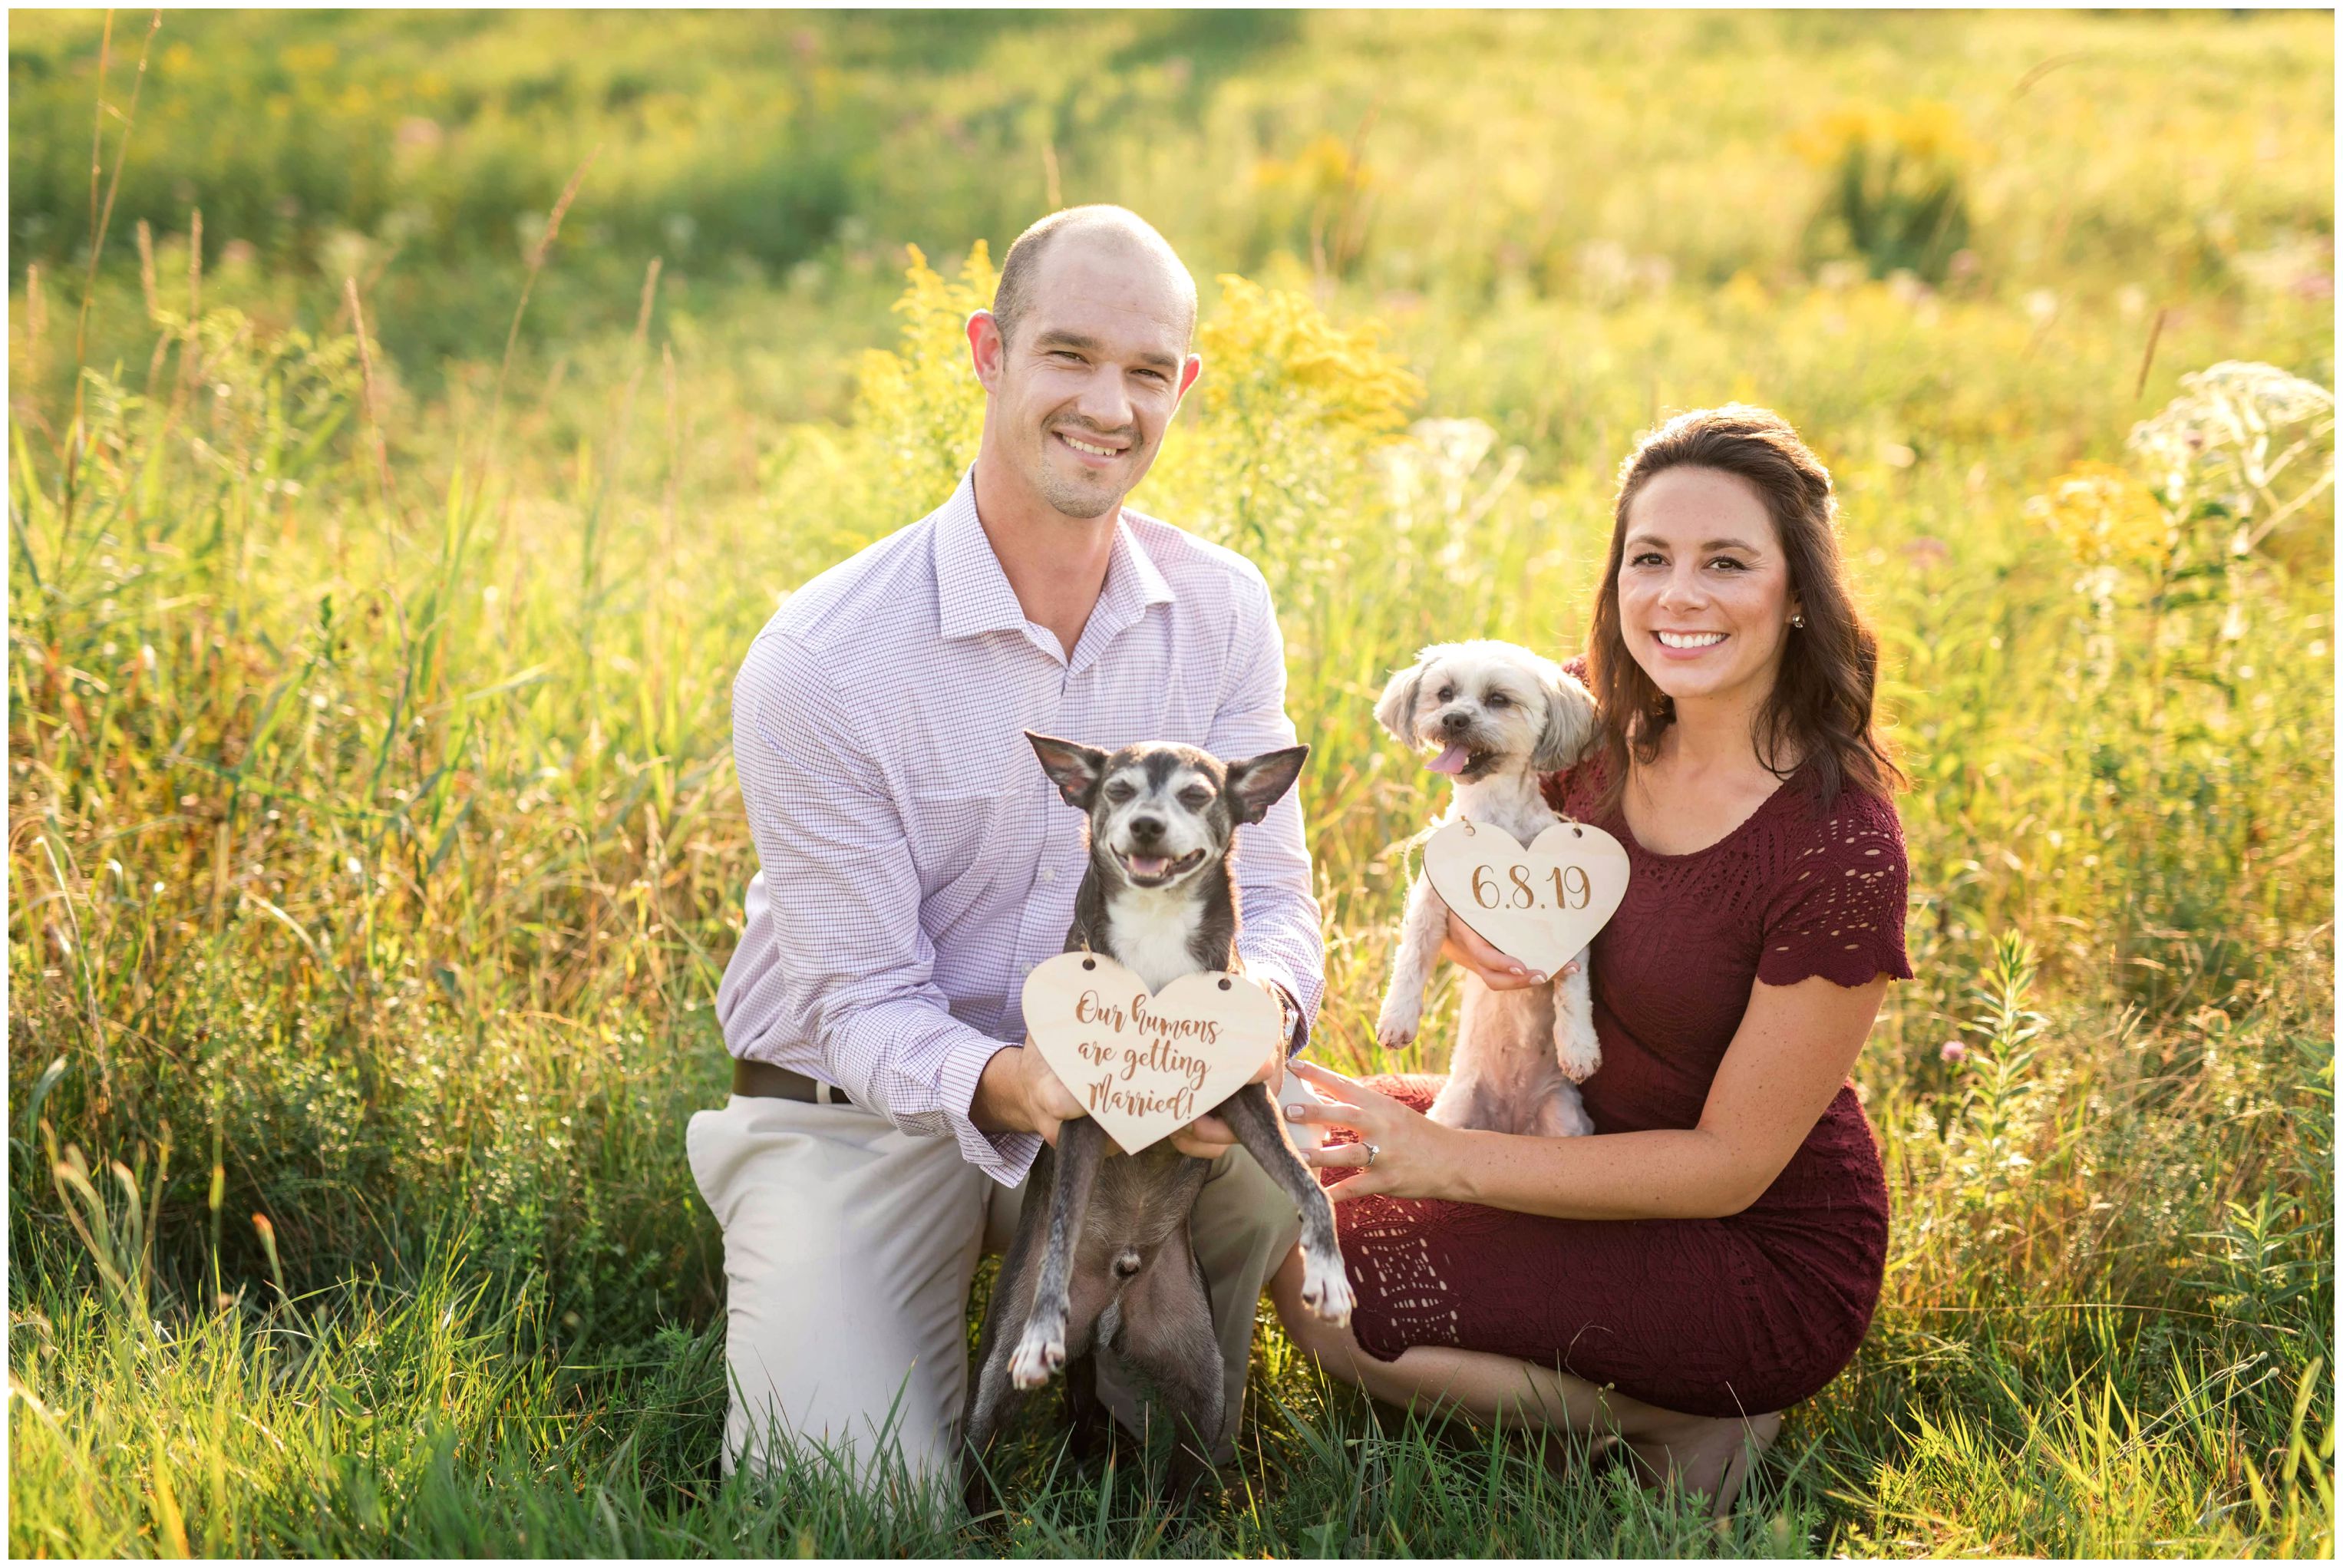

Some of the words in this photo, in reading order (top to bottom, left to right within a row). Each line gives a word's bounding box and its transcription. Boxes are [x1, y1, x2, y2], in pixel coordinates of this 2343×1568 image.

[1471, 864, 1591, 909] 6.8.19
[1075, 989, 1127, 1033] Our
[1131, 993, 1223, 1045] humans
[1077, 1041, 1117, 1067] are
[1120, 1038, 1212, 1091] getting
[1087, 1074, 1194, 1121] Married!
